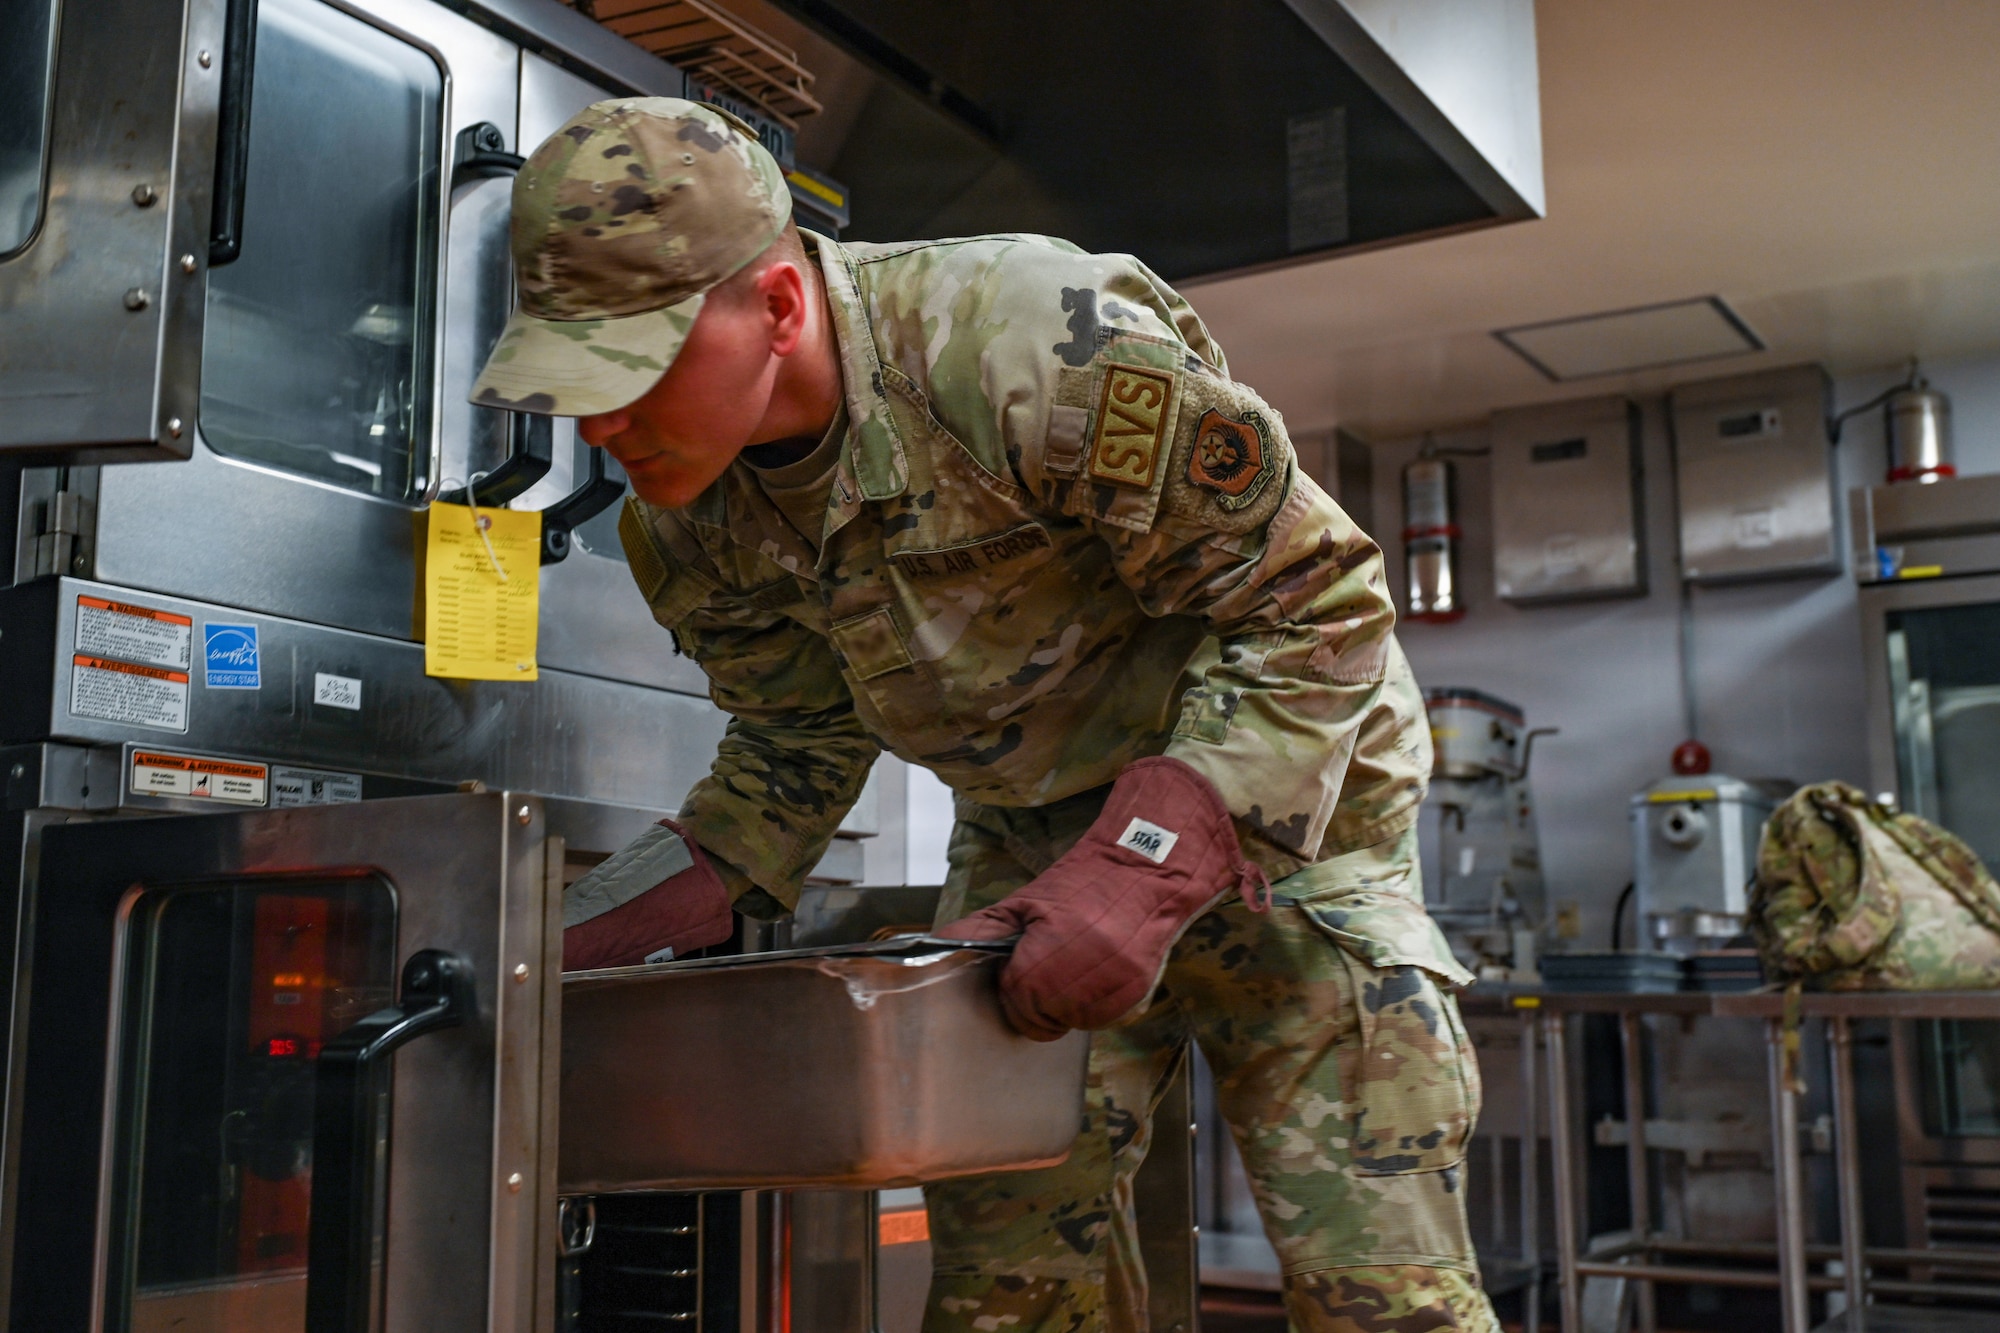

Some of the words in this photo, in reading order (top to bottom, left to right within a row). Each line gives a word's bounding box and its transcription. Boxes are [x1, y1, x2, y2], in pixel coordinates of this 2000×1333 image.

[1101, 379, 1162, 475] SVS
[901, 556, 938, 578] U.S.
[942, 550, 979, 574] AIR
[981, 528, 1050, 564] FORCE
[208, 673, 238, 685] ENERGY
[238, 674, 257, 686] STAR
[145, 756, 185, 769] WARNING
[1128, 831, 1161, 854] STAR
